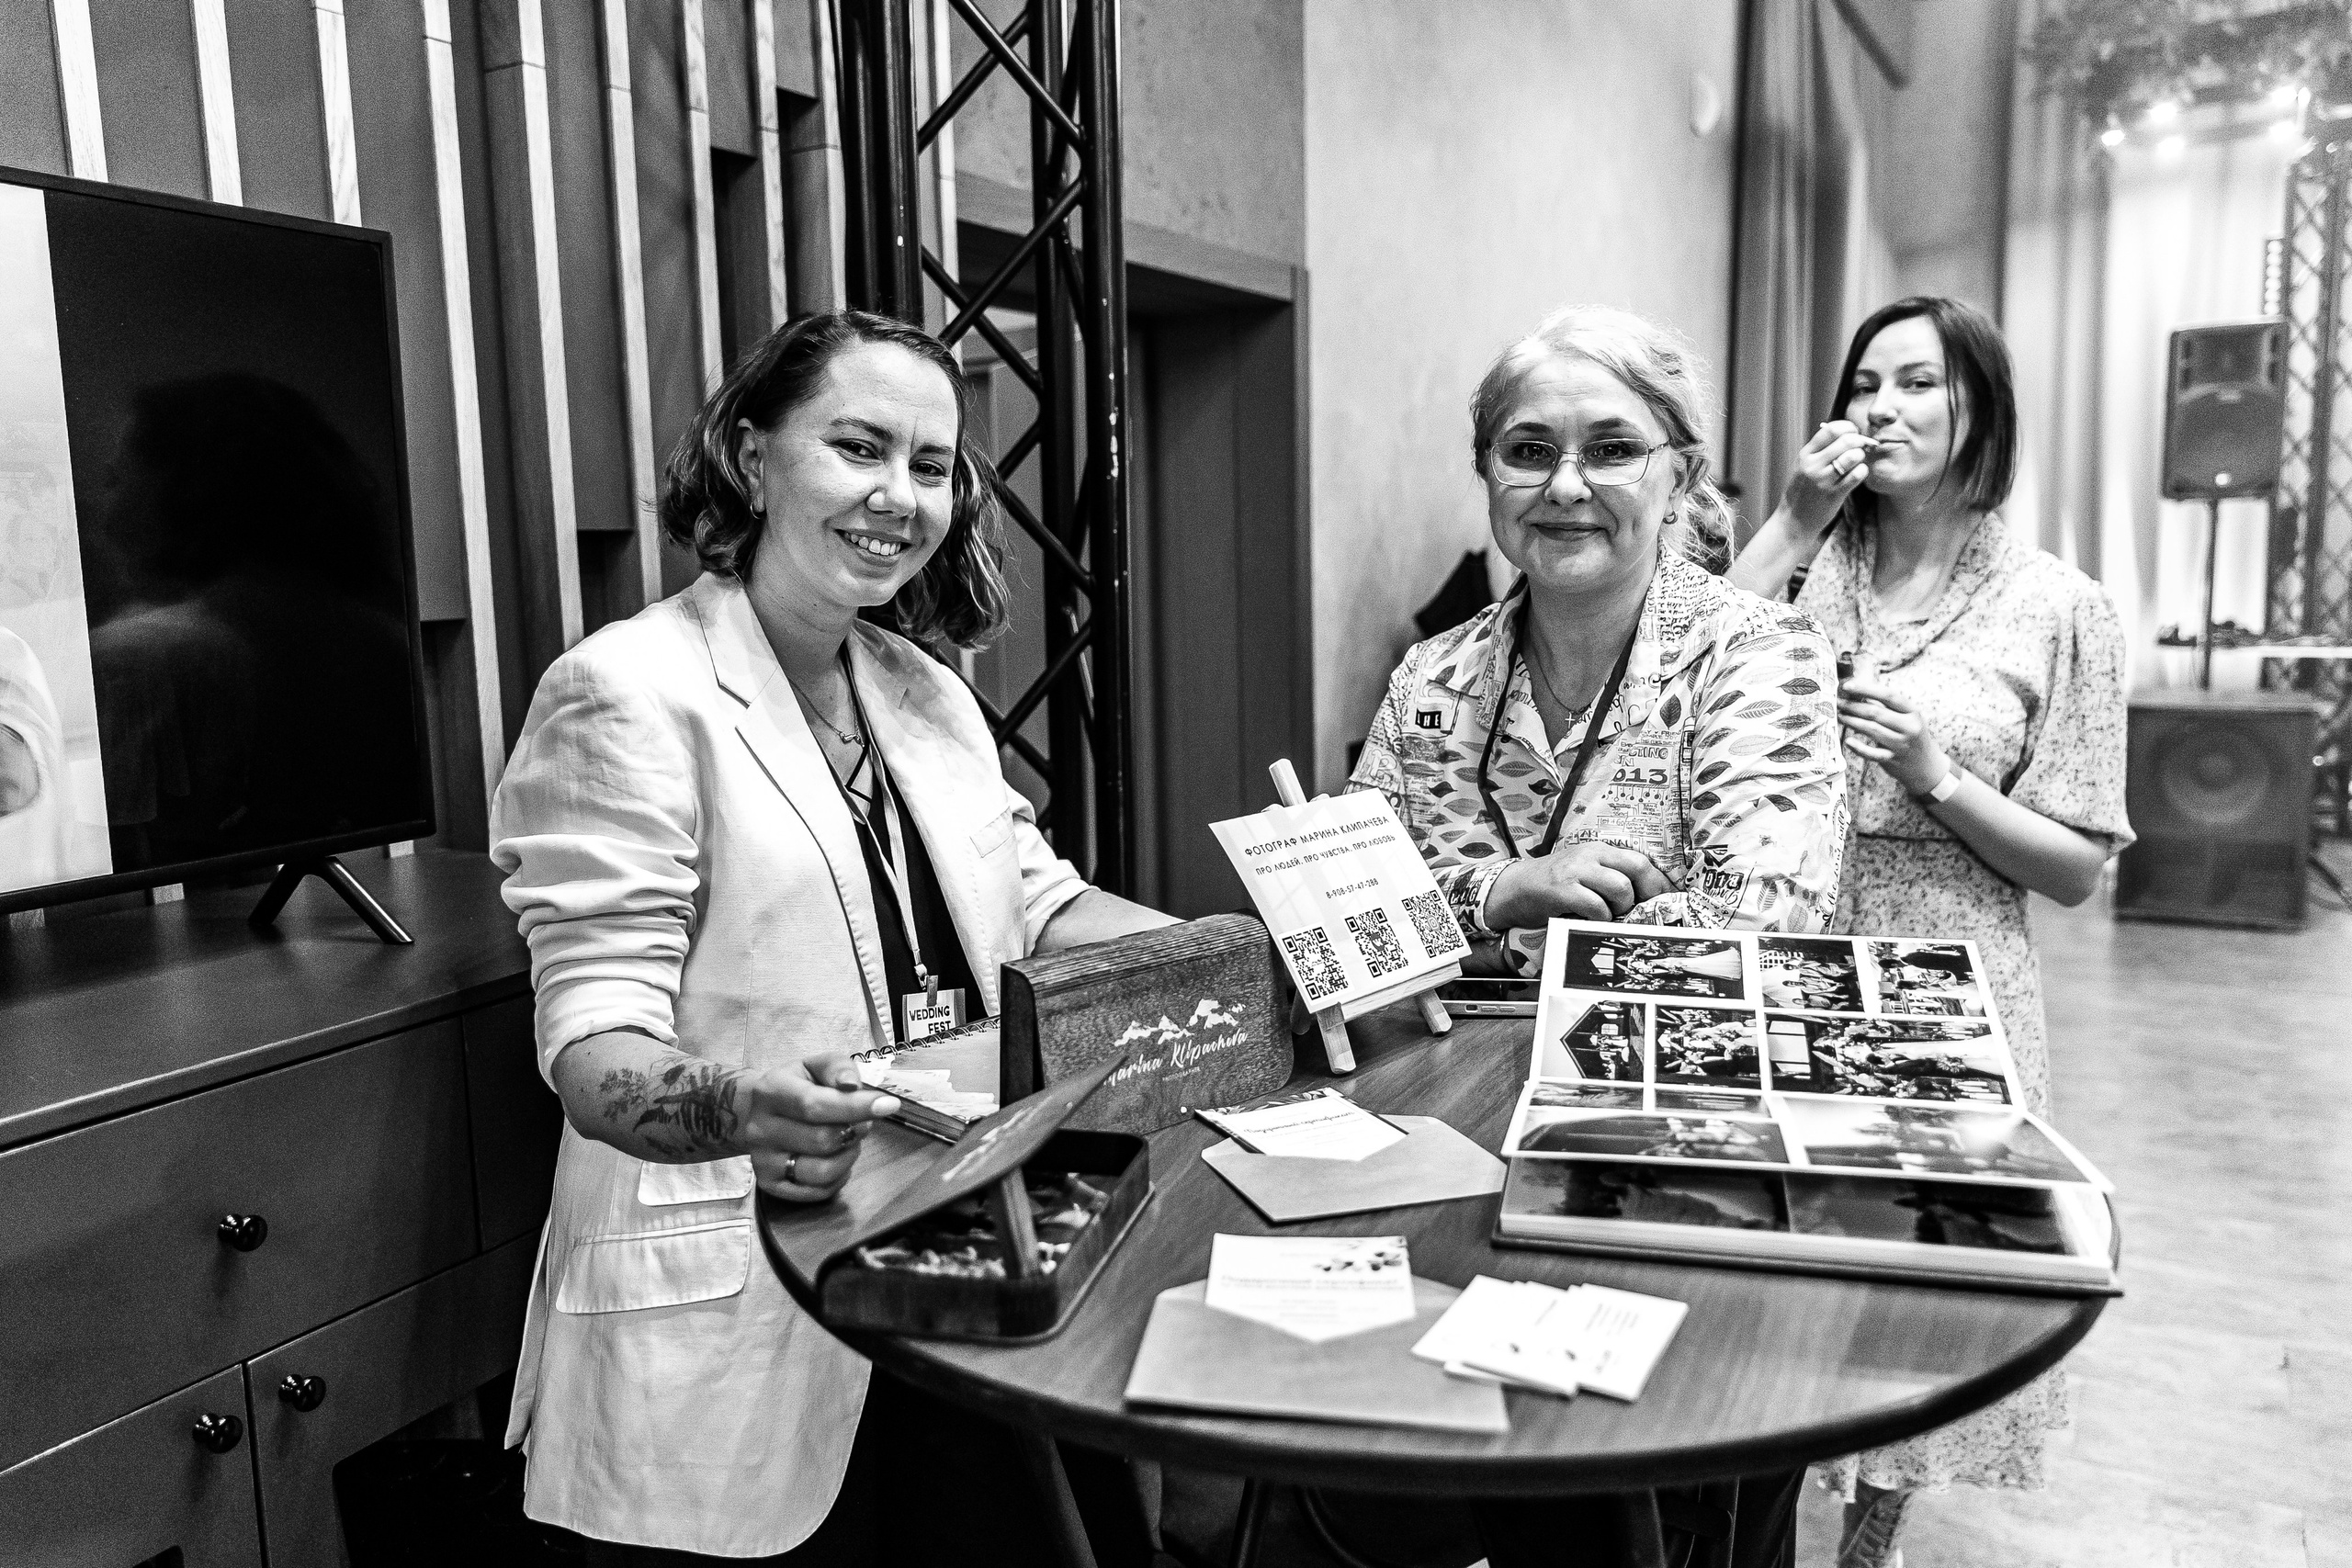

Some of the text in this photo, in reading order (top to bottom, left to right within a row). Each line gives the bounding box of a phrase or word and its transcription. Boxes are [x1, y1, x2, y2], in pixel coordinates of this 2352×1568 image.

[1244, 816, 1390, 857] ФОТОГРАФ МАРИНА КЛИПАЧЕВА
[1255, 865, 1272, 875] ПРО
[1304, 853, 1319, 863] ПРО
[1352, 841, 1367, 851] ПРО
[1369, 834, 1396, 847] ЛЮБОВЬ
[909, 1005, 950, 1021] WEDDING
[928, 1021, 951, 1034] FEST
